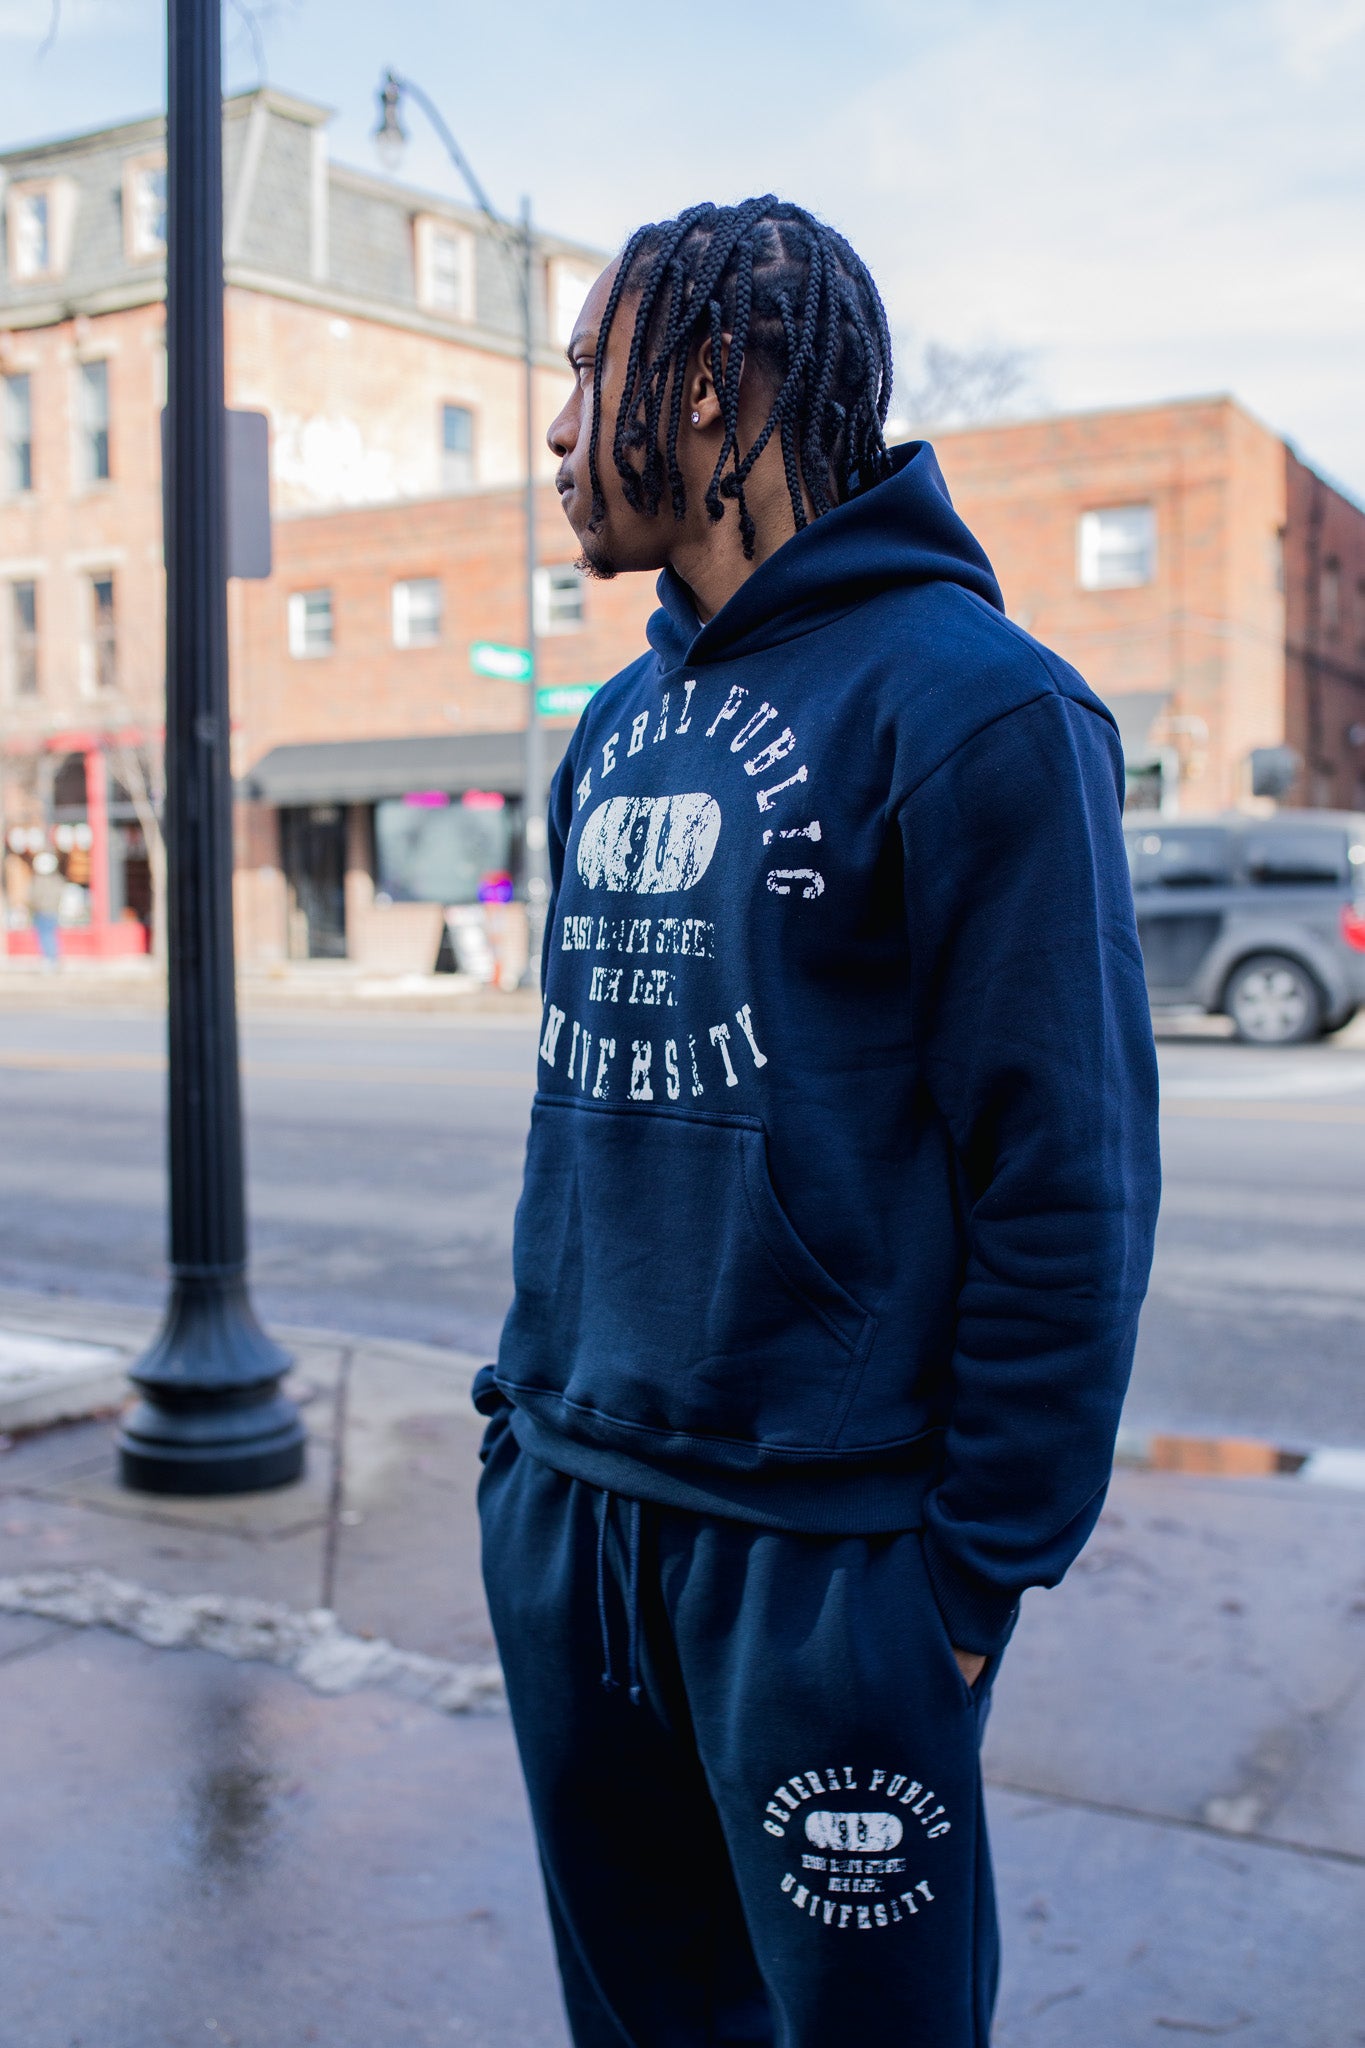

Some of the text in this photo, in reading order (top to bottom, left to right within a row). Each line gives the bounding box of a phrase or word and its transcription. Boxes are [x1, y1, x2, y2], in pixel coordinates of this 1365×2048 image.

[705, 684, 825, 899] PUBLIC
[561, 916, 594, 951] EAST
[540, 1003, 768, 1101] NIVERSITY
[763, 1766, 951, 1839] GENERAL PUBLIC
[780, 1872, 935, 1929] UNIVERSITY
